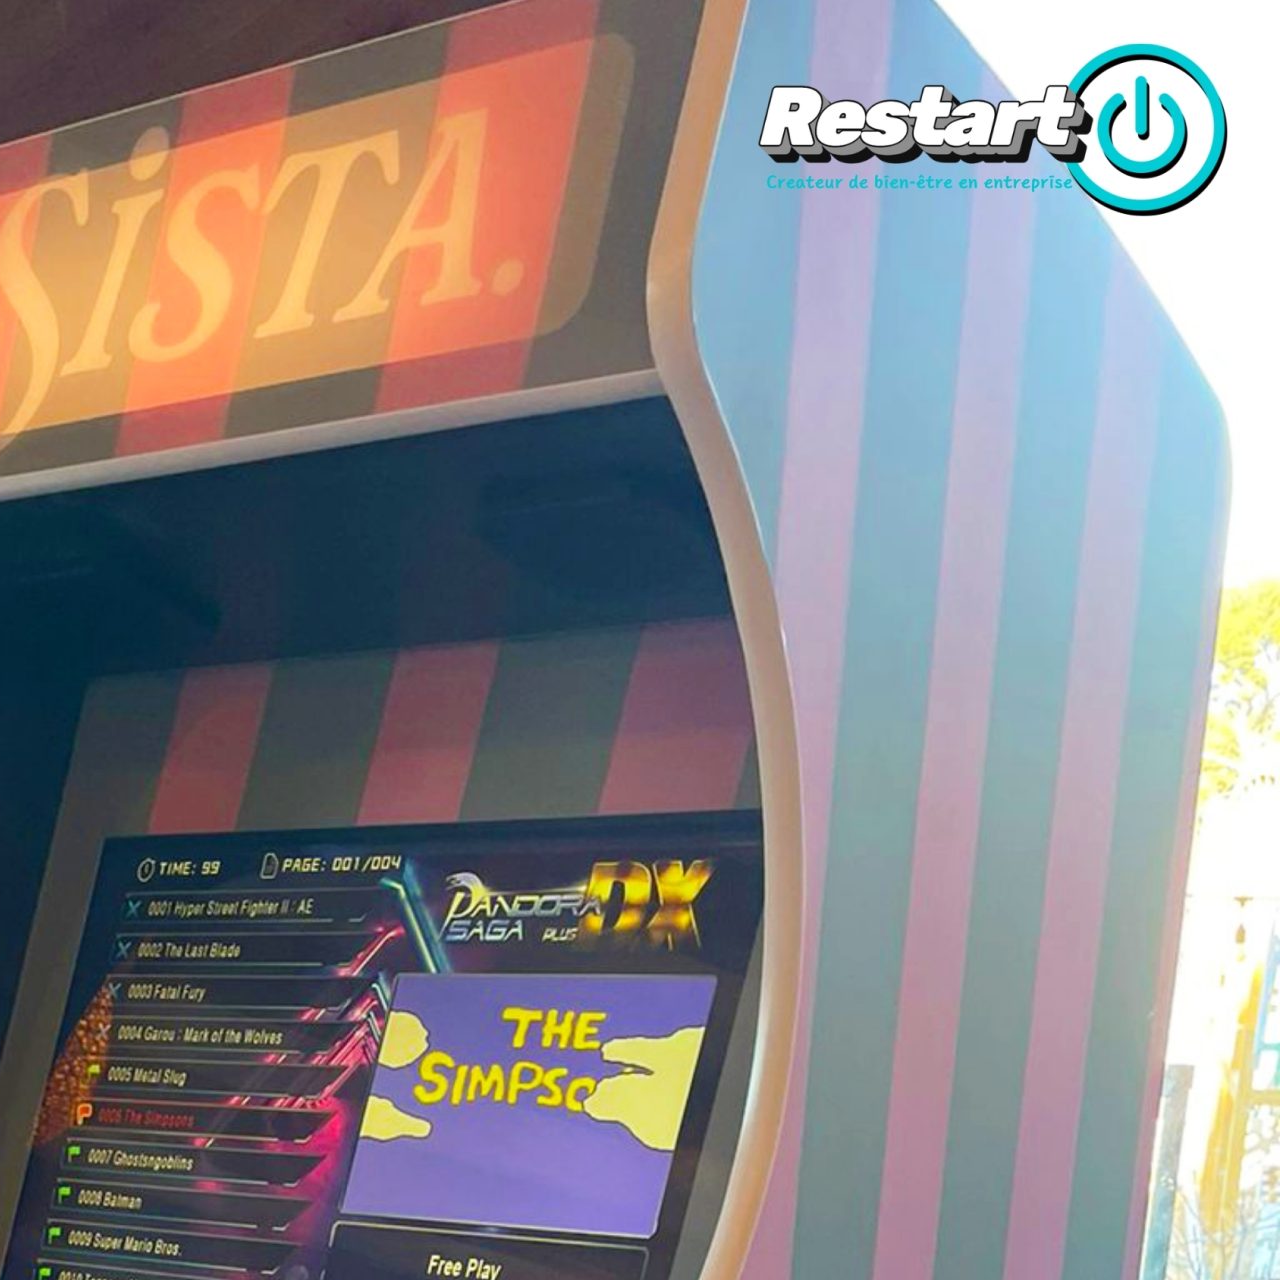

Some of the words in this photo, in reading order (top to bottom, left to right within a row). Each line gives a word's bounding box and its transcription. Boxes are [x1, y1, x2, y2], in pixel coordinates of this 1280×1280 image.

[159, 861, 196, 875] TIME:
[201, 861, 221, 875] 99
[282, 857, 326, 872] PAGE:
[331, 855, 402, 872] 001/004
[147, 901, 173, 917] 0001
[174, 901, 206, 919] Hyper
[240, 899, 280, 918] Fighter
[297, 898, 314, 914] AE
[582, 858, 717, 950] DX
[445, 919, 524, 942] SAGA
[137, 943, 163, 958] 0002
[164, 942, 183, 958] The
[184, 942, 208, 958] Last
[209, 942, 241, 958] Blade
[127, 984, 152, 1000] 0003
[153, 983, 181, 1001] Fatal
[181, 984, 207, 1005] Fury
[117, 1025, 143, 1041] 0004
[144, 1026, 176, 1042] Garou
[183, 1027, 210, 1043] Mark
[211, 1027, 224, 1043] of
[224, 1027, 243, 1044] the
[243, 1028, 284, 1046] Wolves
[501, 1005, 608, 1050] THE
[107, 1067, 132, 1082] 0005
[133, 1067, 162, 1083] Metal
[162, 1068, 187, 1087] Slug
[87, 1148, 111, 1164] 0007
[67, 1230, 92, 1246] 0009
[93, 1232, 123, 1251] Super
[124, 1236, 154, 1254] Mario
[155, 1239, 182, 1256] Bros.
[426, 1253, 463, 1278] Free
